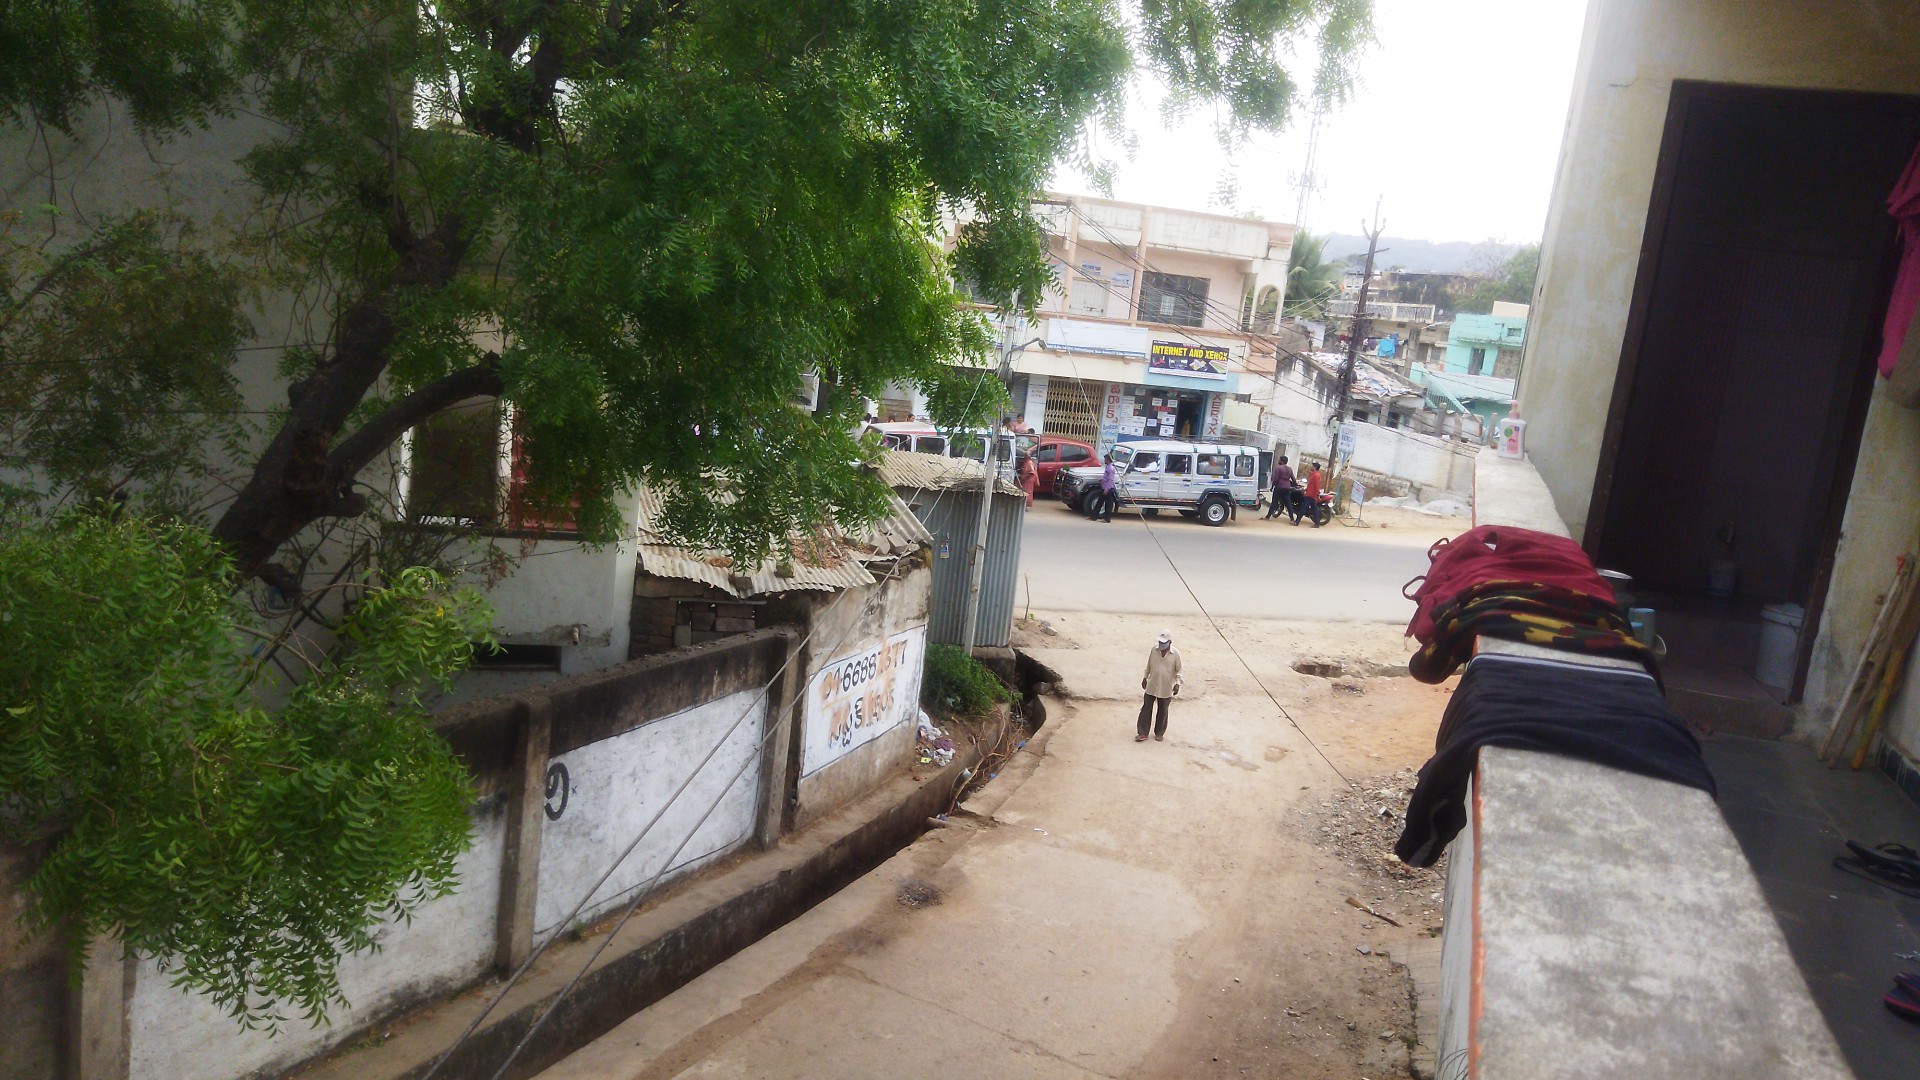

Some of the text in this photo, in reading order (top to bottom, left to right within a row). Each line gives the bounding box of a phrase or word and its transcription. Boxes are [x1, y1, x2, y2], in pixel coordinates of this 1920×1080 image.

[1152, 344, 1188, 357] INTERNET
[1188, 348, 1204, 359] AND
[1204, 349, 1228, 361] XEROX
